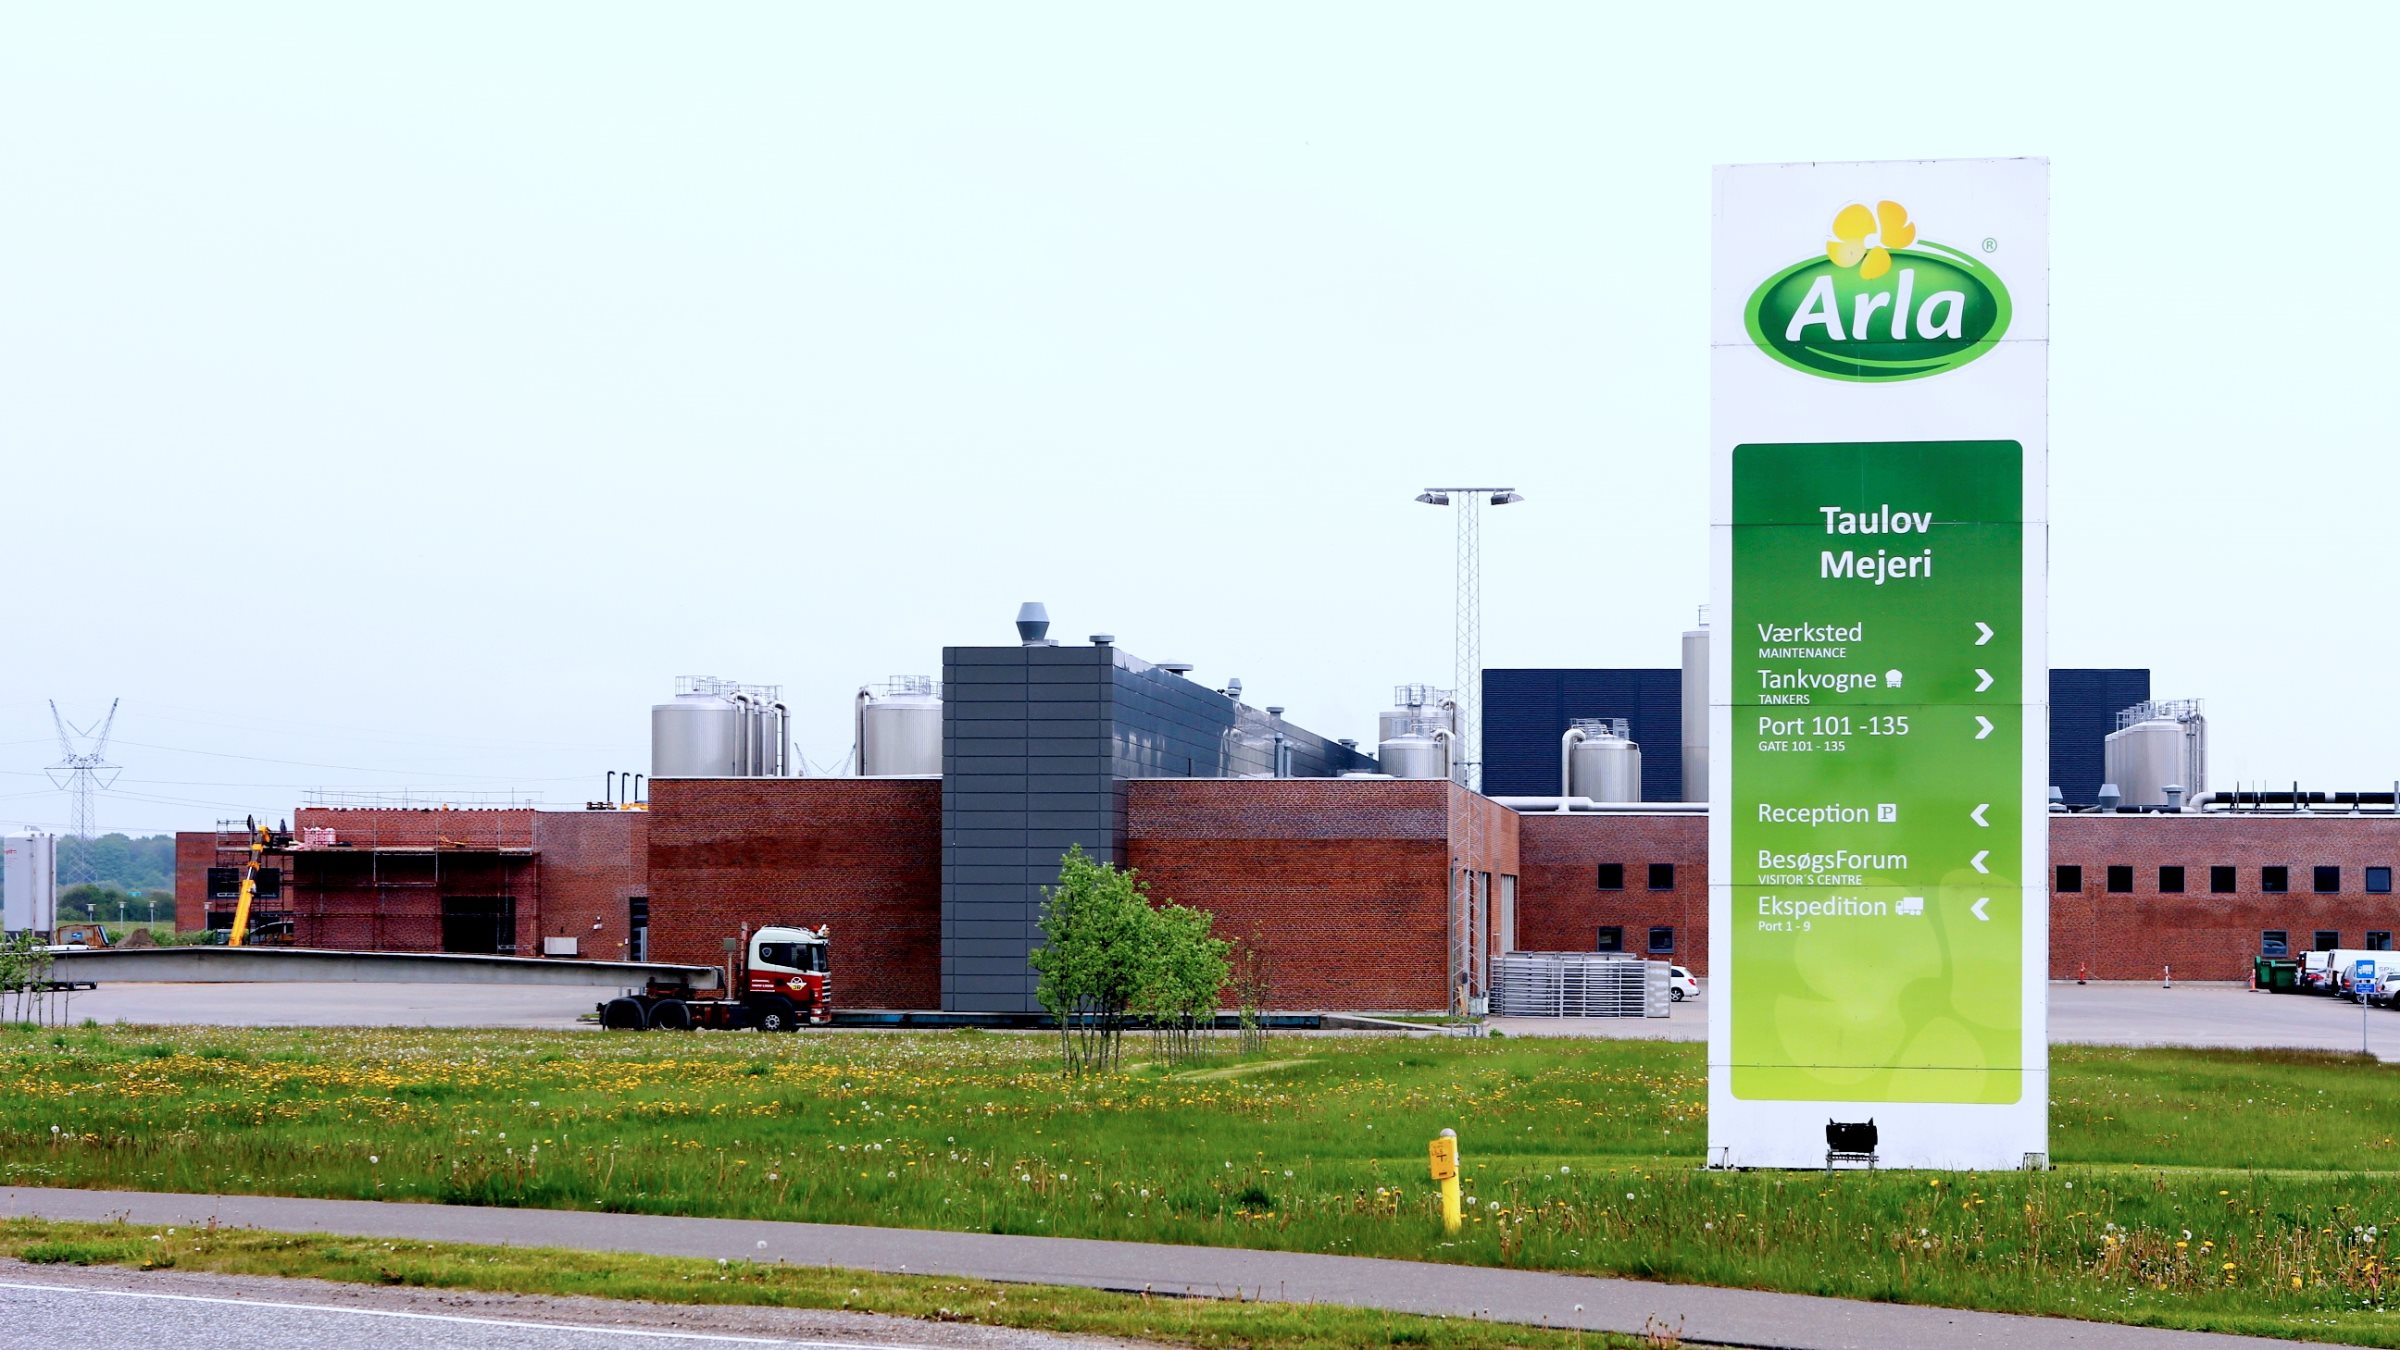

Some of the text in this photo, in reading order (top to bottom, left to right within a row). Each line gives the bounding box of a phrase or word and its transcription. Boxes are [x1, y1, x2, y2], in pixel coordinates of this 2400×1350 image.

[1785, 268, 1965, 342] Arla
[1819, 504, 1932, 534] Taulov
[1820, 549, 1931, 585] Mejeri
[1758, 622, 1862, 642] Værksted
[1758, 647, 1846, 659] MAINTENANCE
[1758, 669, 1876, 692] Tankvogne
[1758, 694, 1810, 705] TANKERS
[1759, 716, 1804, 735] Port
[1812, 716, 1852, 735] 101
[1759, 741, 1788, 752] GATE
[1792, 741, 1813, 752] 101
[1825, 741, 1846, 752] 135
[1759, 804, 1869, 827] Reception
[1759, 850, 1907, 873] BesøgsForum
[1817, 874, 1862, 885] CENTRE
[1759, 896, 1887, 919] Ekspedition
[1759, 921, 1783, 932] Port
[1786, 921, 1792, 932] 1
[1804, 921, 1811, 932] 9
